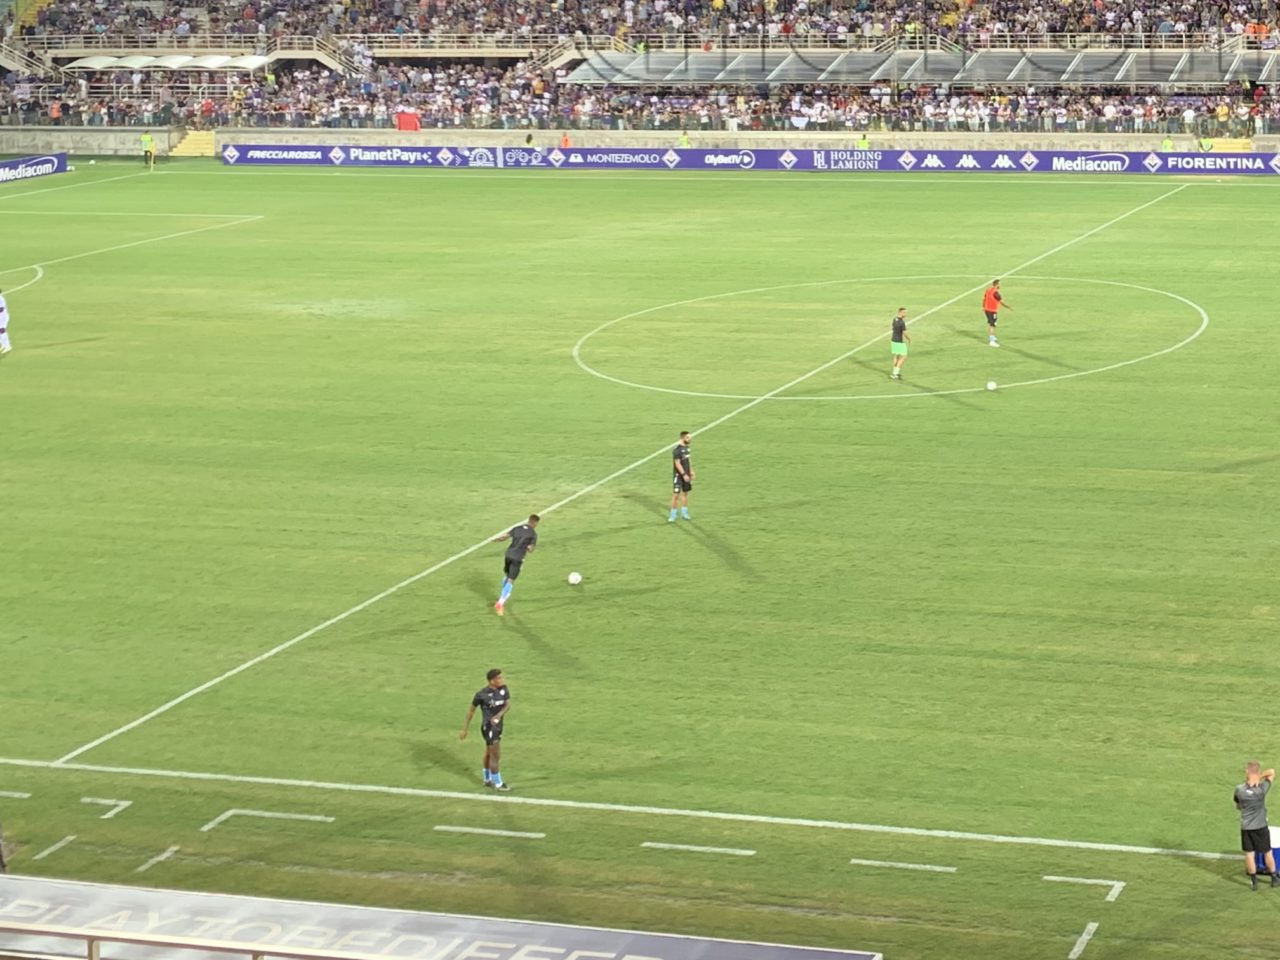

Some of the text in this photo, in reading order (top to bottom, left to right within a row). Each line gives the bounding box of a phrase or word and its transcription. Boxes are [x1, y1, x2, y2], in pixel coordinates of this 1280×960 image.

[247, 150, 323, 160] FRECCIAROSSA
[586, 153, 660, 164] MONTEZEMOLO
[830, 151, 883, 161] HOLDING
[830, 160, 880, 169] LAMIONI
[1052, 156, 1122, 172] Mediacom
[1167, 156, 1265, 170] FIORENTINA
[0, 162, 53, 182] Mediacom
